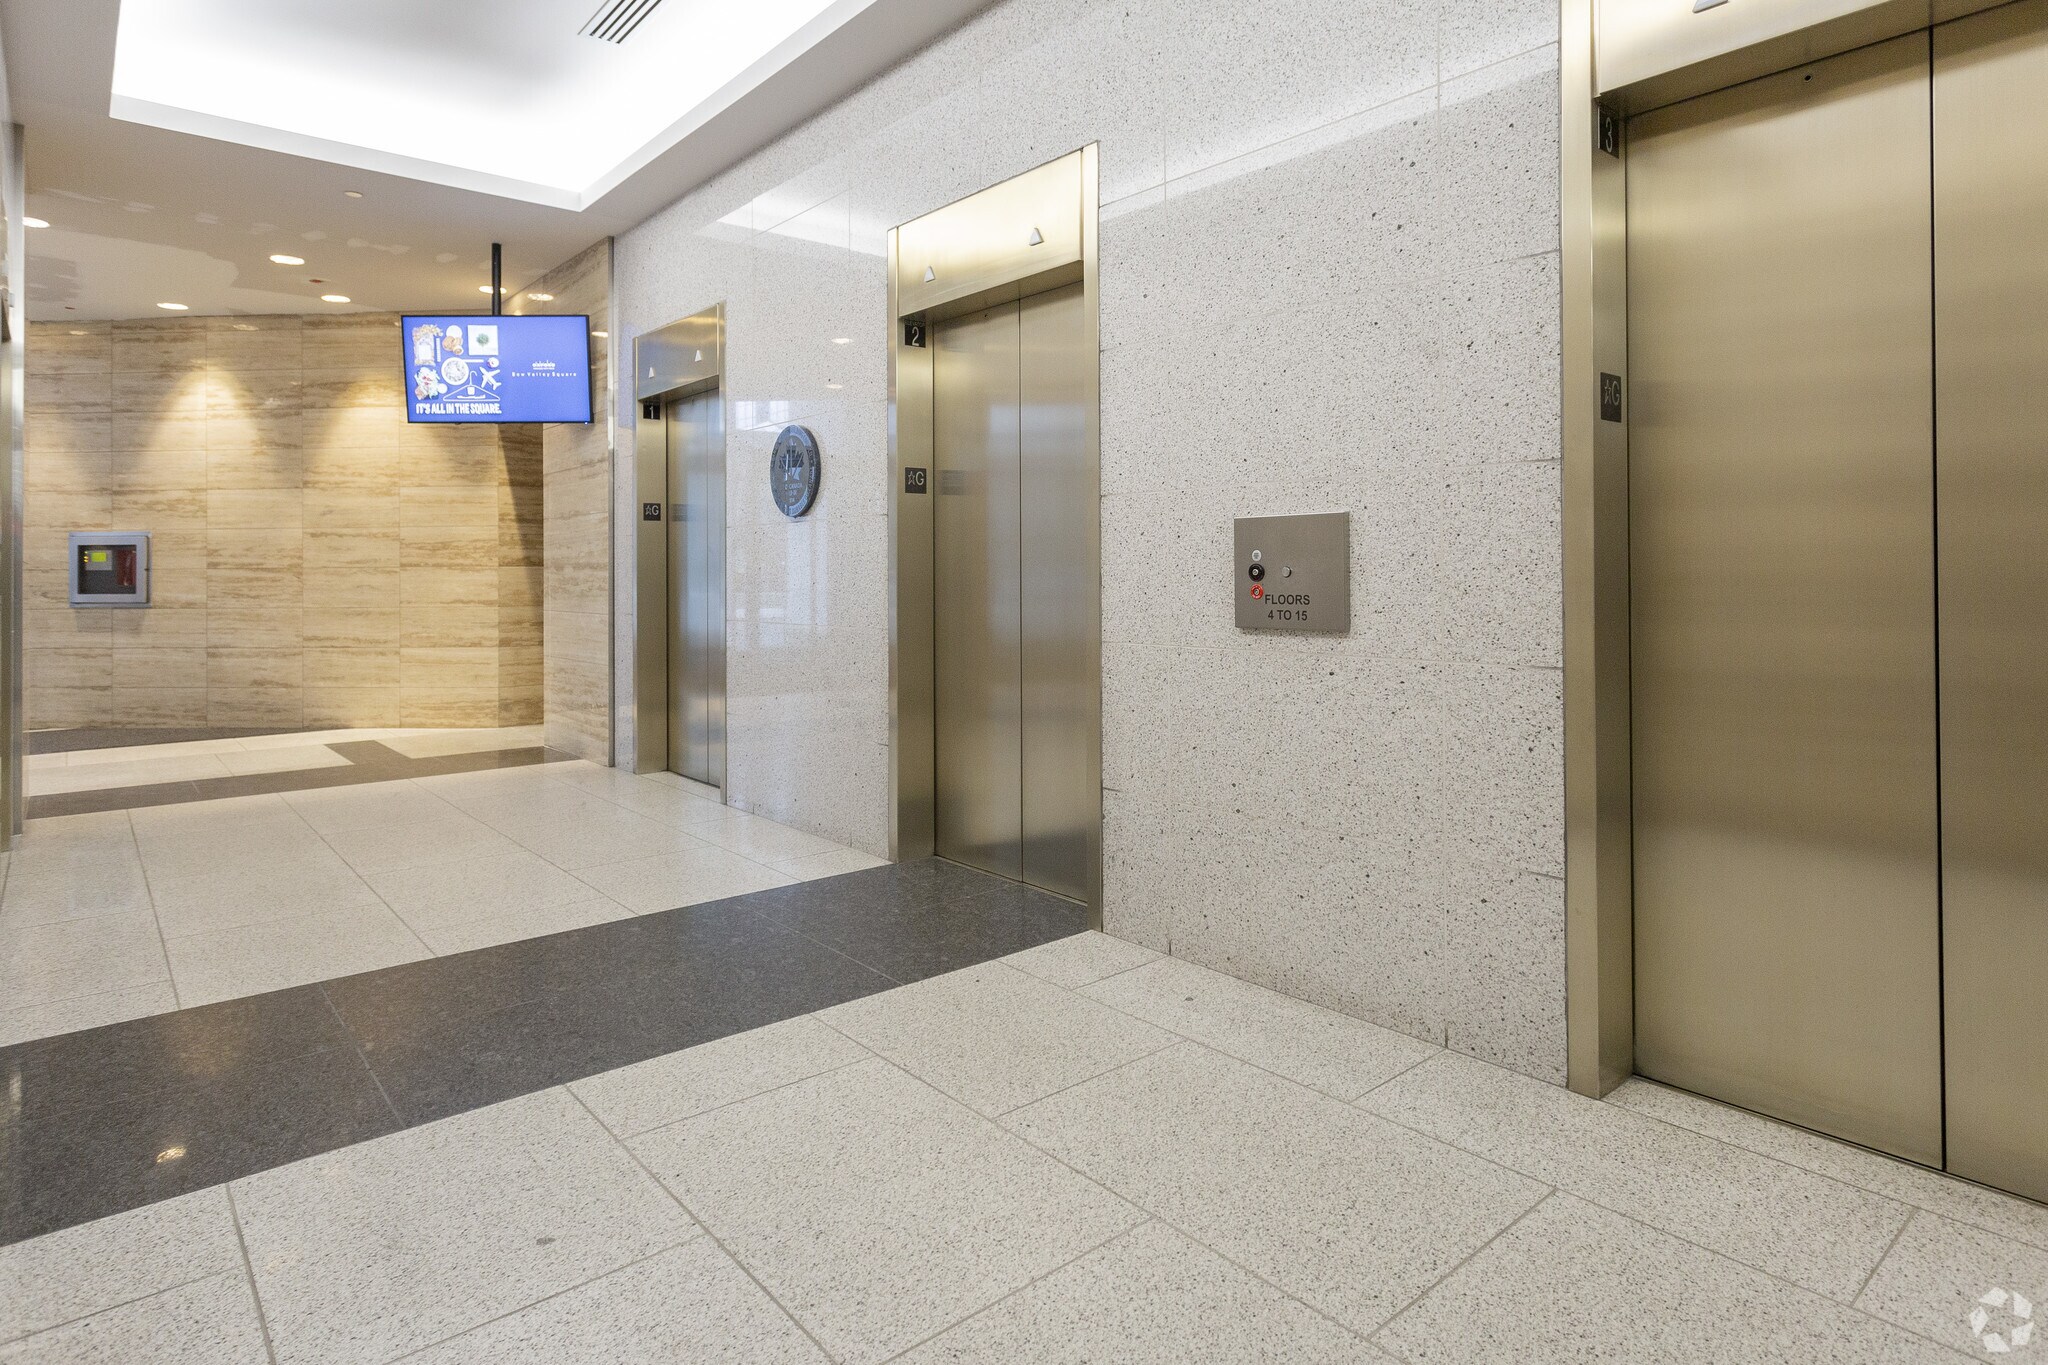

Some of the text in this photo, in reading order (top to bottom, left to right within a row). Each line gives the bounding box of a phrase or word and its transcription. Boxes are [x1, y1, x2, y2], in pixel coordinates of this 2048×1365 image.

[1605, 116, 1613, 153] 3
[911, 326, 920, 347] 2
[1611, 380, 1621, 406] G
[415, 402, 502, 415] IT'S ALL IN THE SQUARE.
[649, 405, 654, 420] 1
[915, 471, 925, 486] G
[651, 504, 660, 516] G
[1264, 594, 1310, 605] FLOORS
[1267, 610, 1308, 621] 4 TO 15
